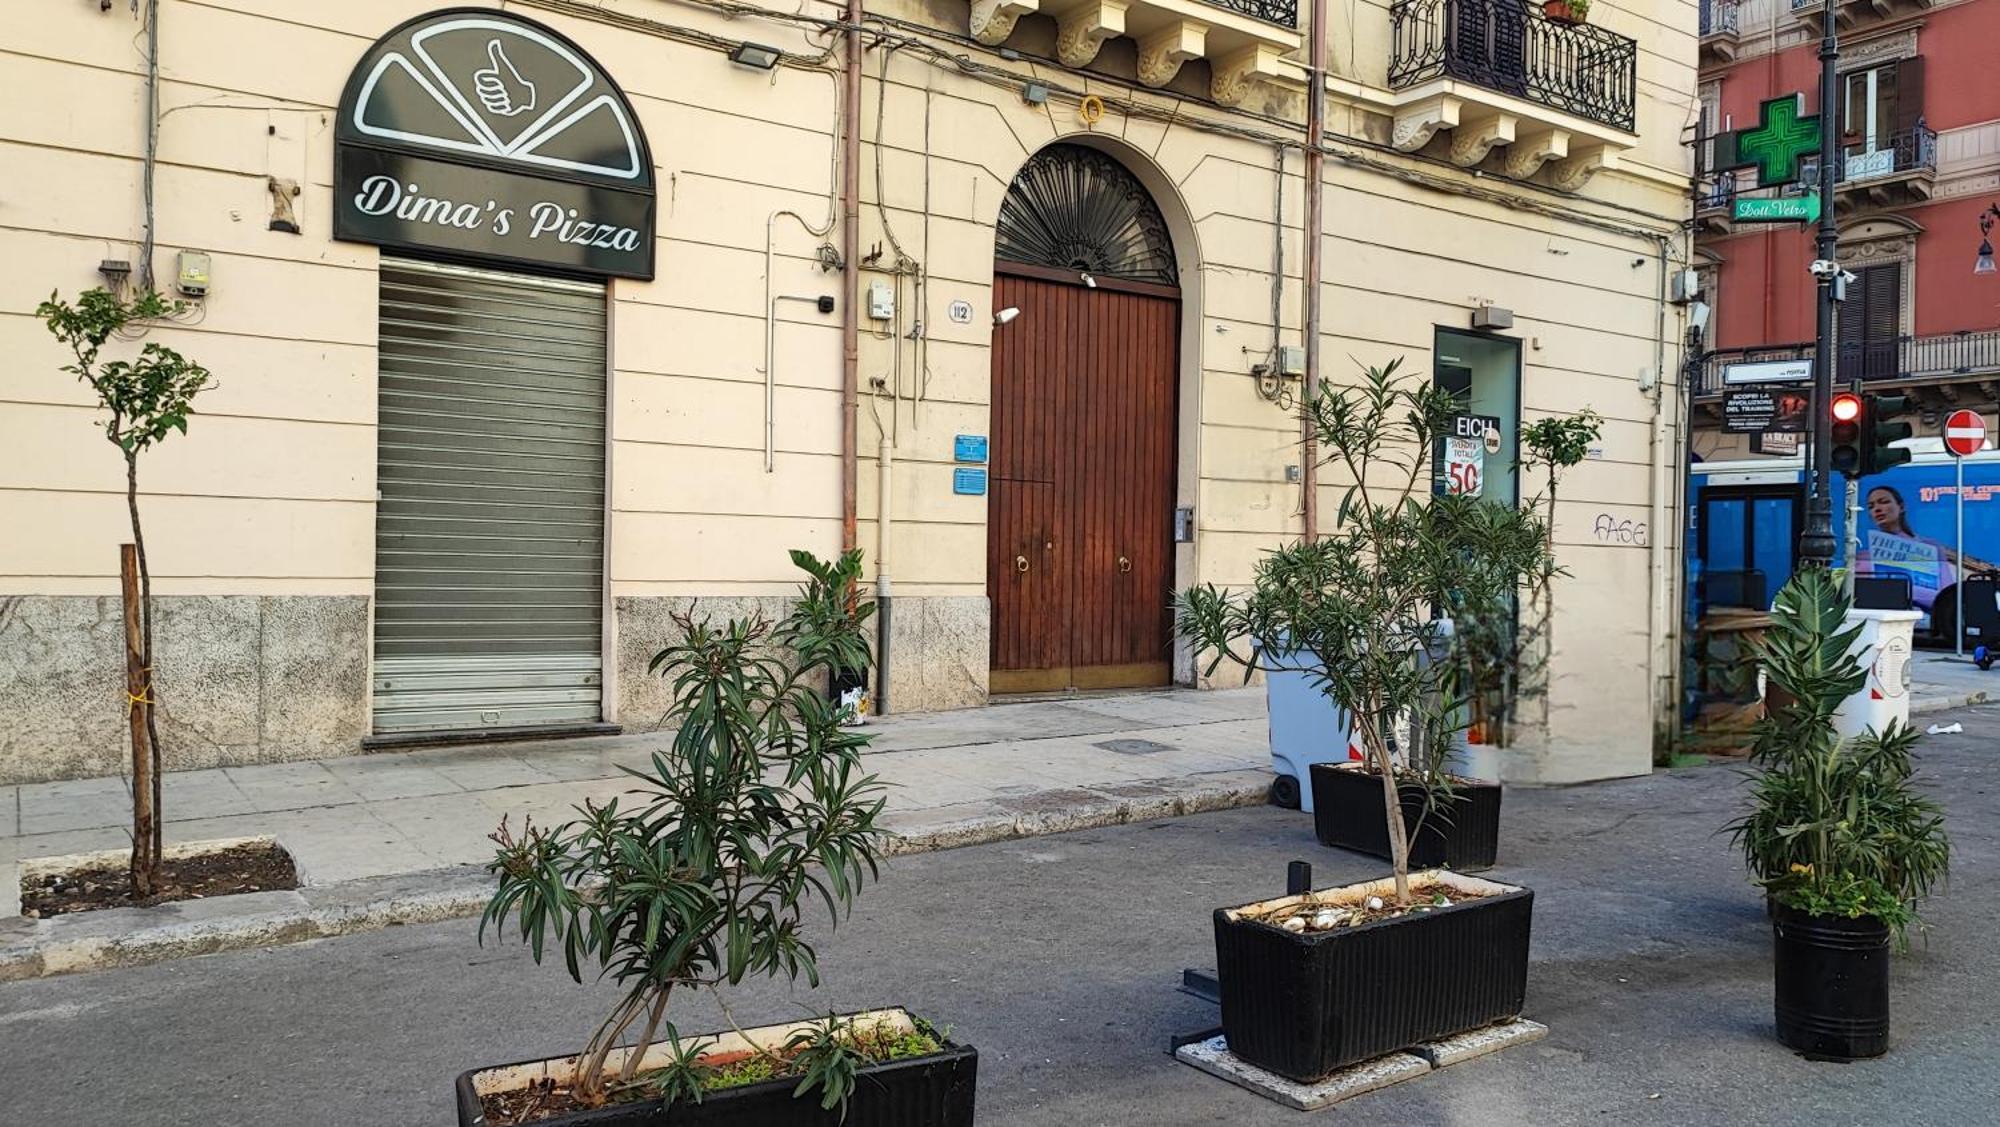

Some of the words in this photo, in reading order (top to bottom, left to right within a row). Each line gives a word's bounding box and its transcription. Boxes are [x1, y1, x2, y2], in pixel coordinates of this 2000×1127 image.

[354, 175, 515, 236] Dima's
[530, 201, 641, 252] Pizza
[953, 306, 968, 320] 112
